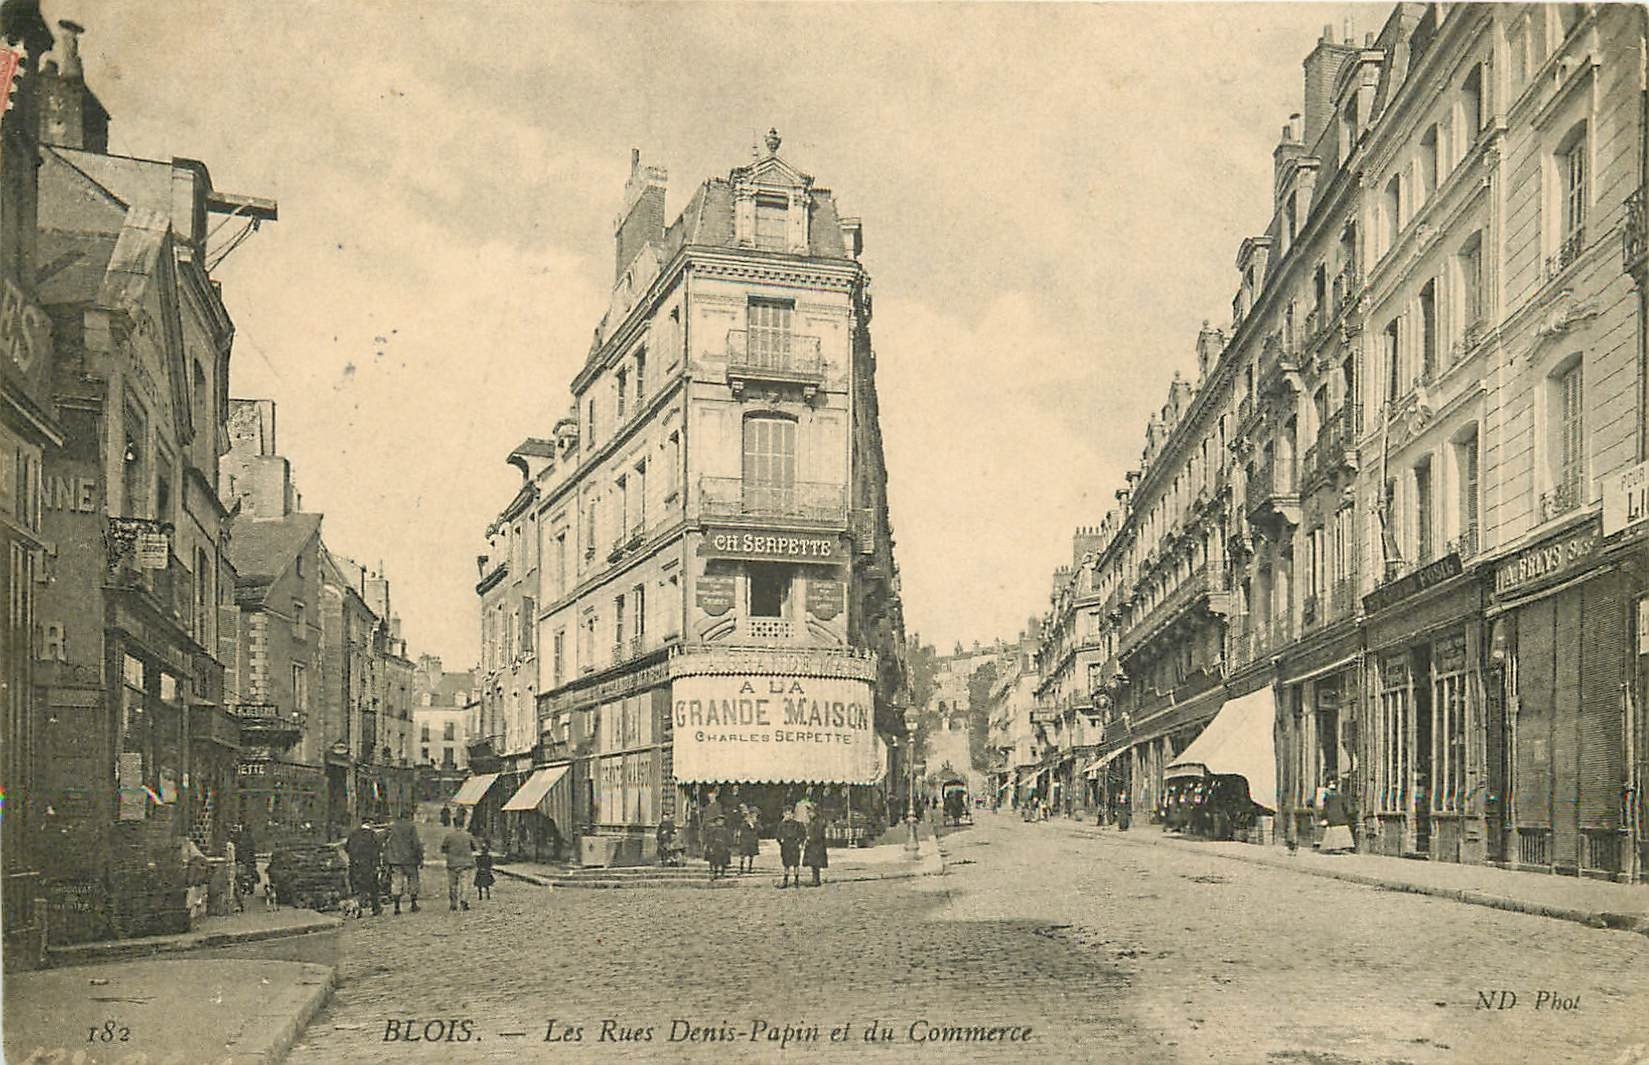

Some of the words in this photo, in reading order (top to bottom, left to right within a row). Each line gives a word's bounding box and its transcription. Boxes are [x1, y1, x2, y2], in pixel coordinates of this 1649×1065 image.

[743, 534, 831, 556] SERPETTE
[739, 680, 755, 694] A
[769, 680, 804, 695] LA
[675, 699, 771, 727] GRANDE
[783, 697, 868, 731] MAISON
[695, 730, 770, 742] CHARLES
[774, 729, 853, 744] SERPETTE
